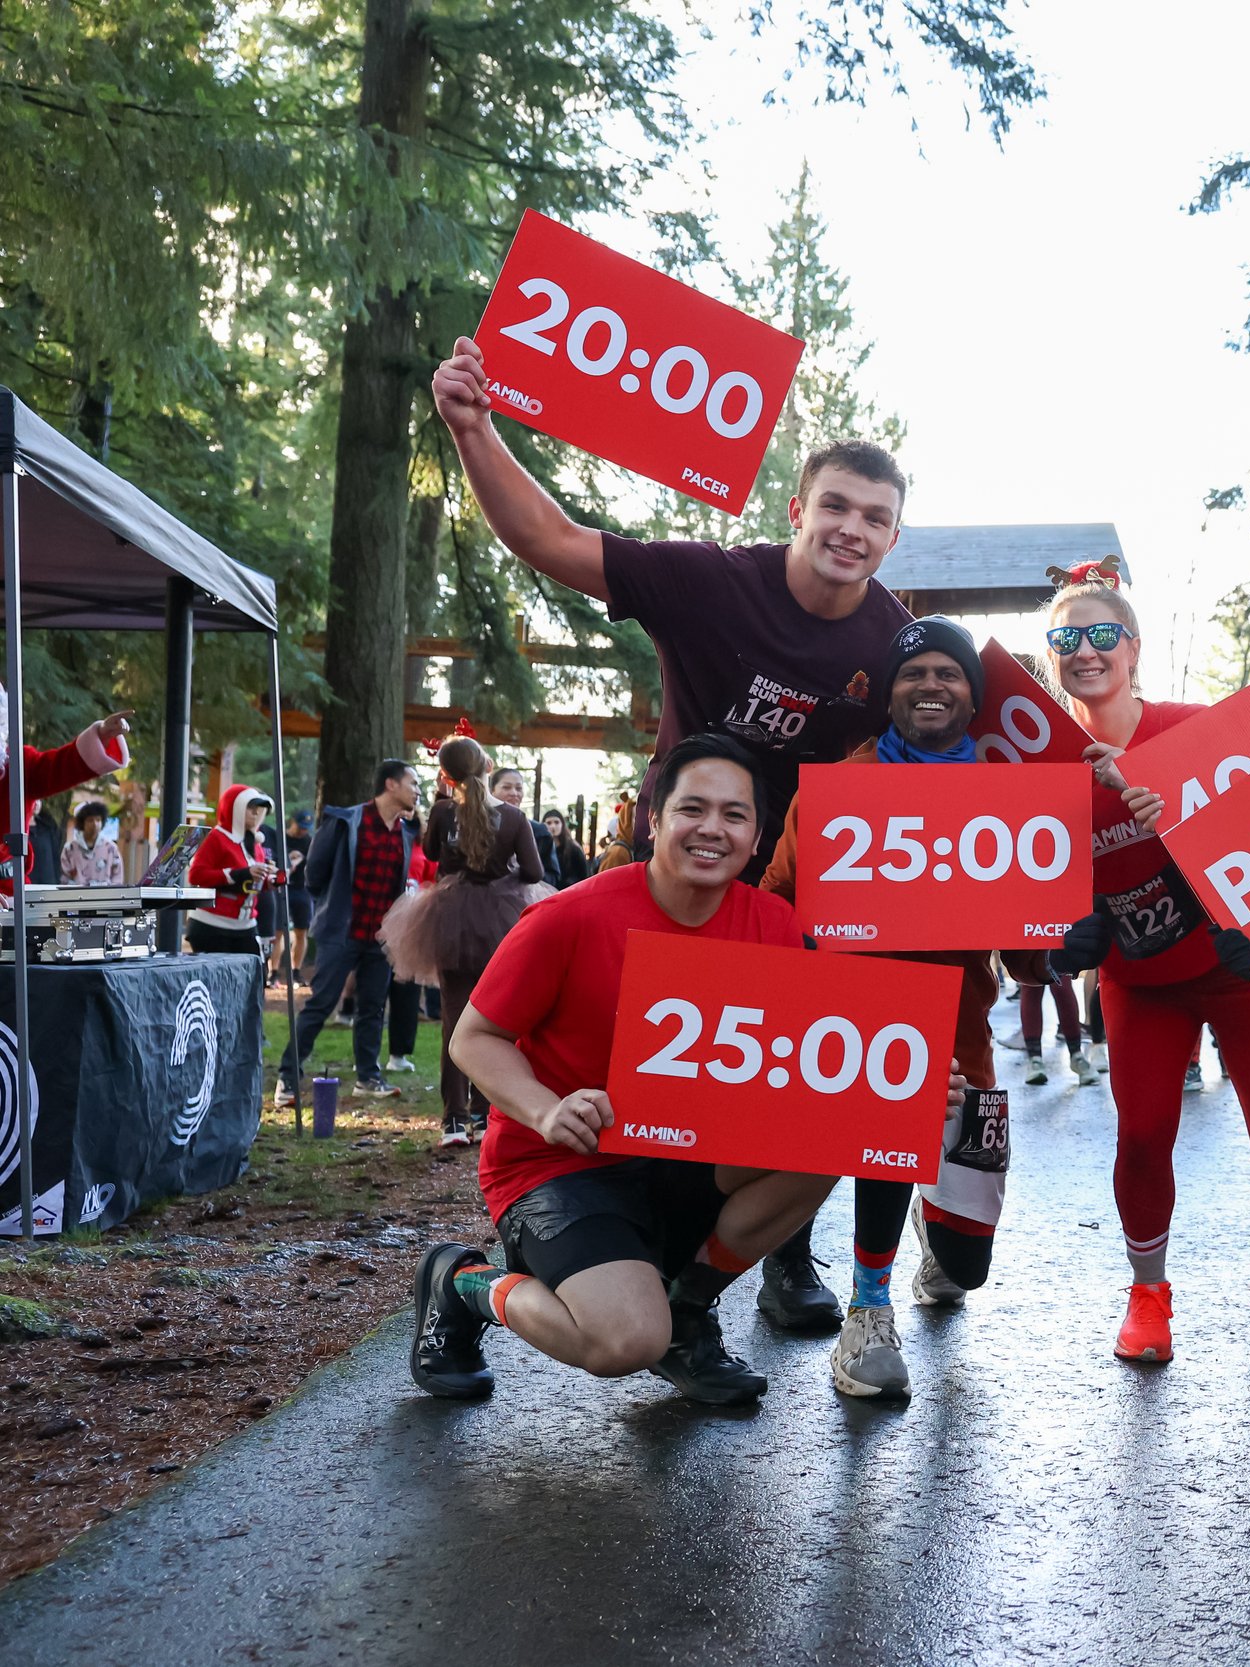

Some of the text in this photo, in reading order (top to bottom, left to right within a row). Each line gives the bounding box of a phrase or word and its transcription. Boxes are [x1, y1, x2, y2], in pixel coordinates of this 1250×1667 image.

[499, 277, 764, 439] 20:00
[485, 377, 543, 416] AMINO
[681, 467, 730, 499] PACER
[749, 683, 780, 705] RUN
[752, 674, 819, 705] RUDOLPH
[743, 698, 807, 738] 140
[819, 814, 1072, 882] 25:00
[813, 924, 878, 941] KAMINO
[1119, 896, 1182, 940] 122
[636, 997, 929, 1101] 25:00
[977, 1105, 1000, 1117] RUN
[623, 1123, 698, 1148] KAMINO
[982, 1117, 1008, 1149] 63
[862, 1148, 918, 1169] PACER
